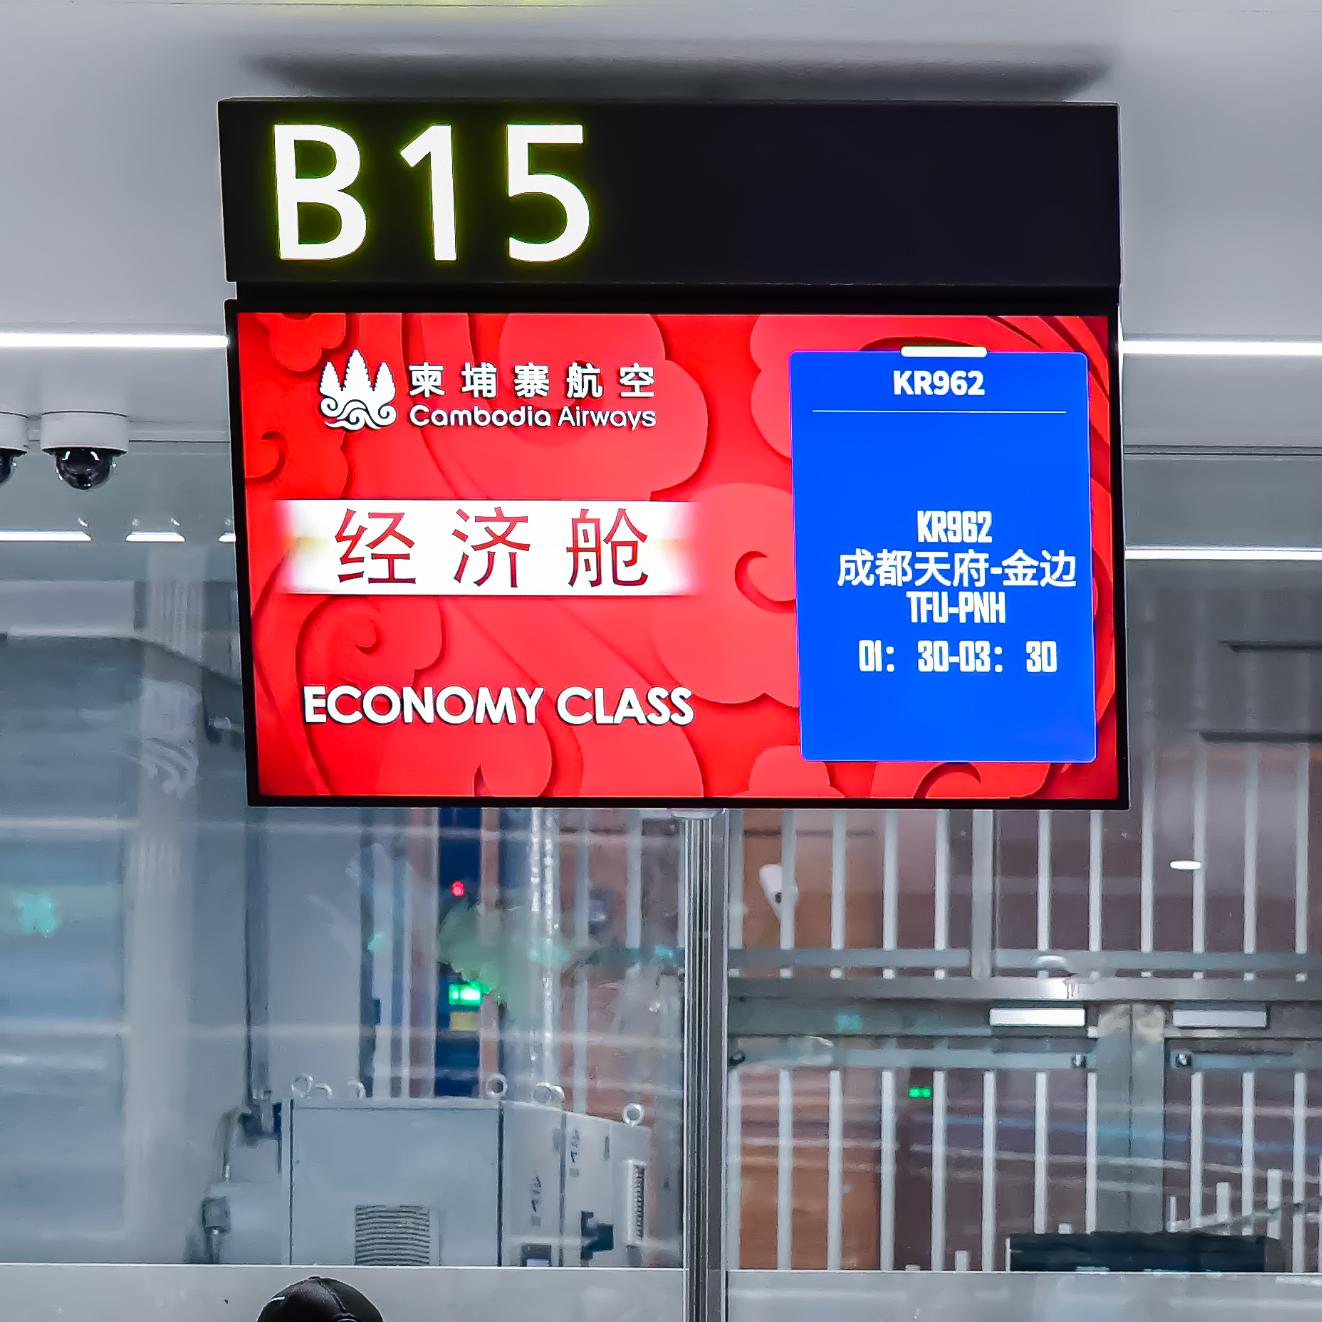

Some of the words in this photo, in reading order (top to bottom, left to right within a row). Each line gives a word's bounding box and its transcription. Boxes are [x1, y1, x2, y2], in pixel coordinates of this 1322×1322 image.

[275, 125, 589, 261] B15
[409, 362, 654, 398] 柬埔寨航空
[894, 371, 984, 395] KR962
[410, 405, 550, 426] Cambodia
[558, 406, 656, 430] Airways
[918, 511, 992, 542] KR962
[335, 507, 648, 587] 经济舱
[838, 549, 1075, 586] 成都天府-金边
[907, 592, 1005, 623] TFU-PNH
[304, 686, 543, 723] ECONOMY
[558, 687, 693, 724] CLASS
